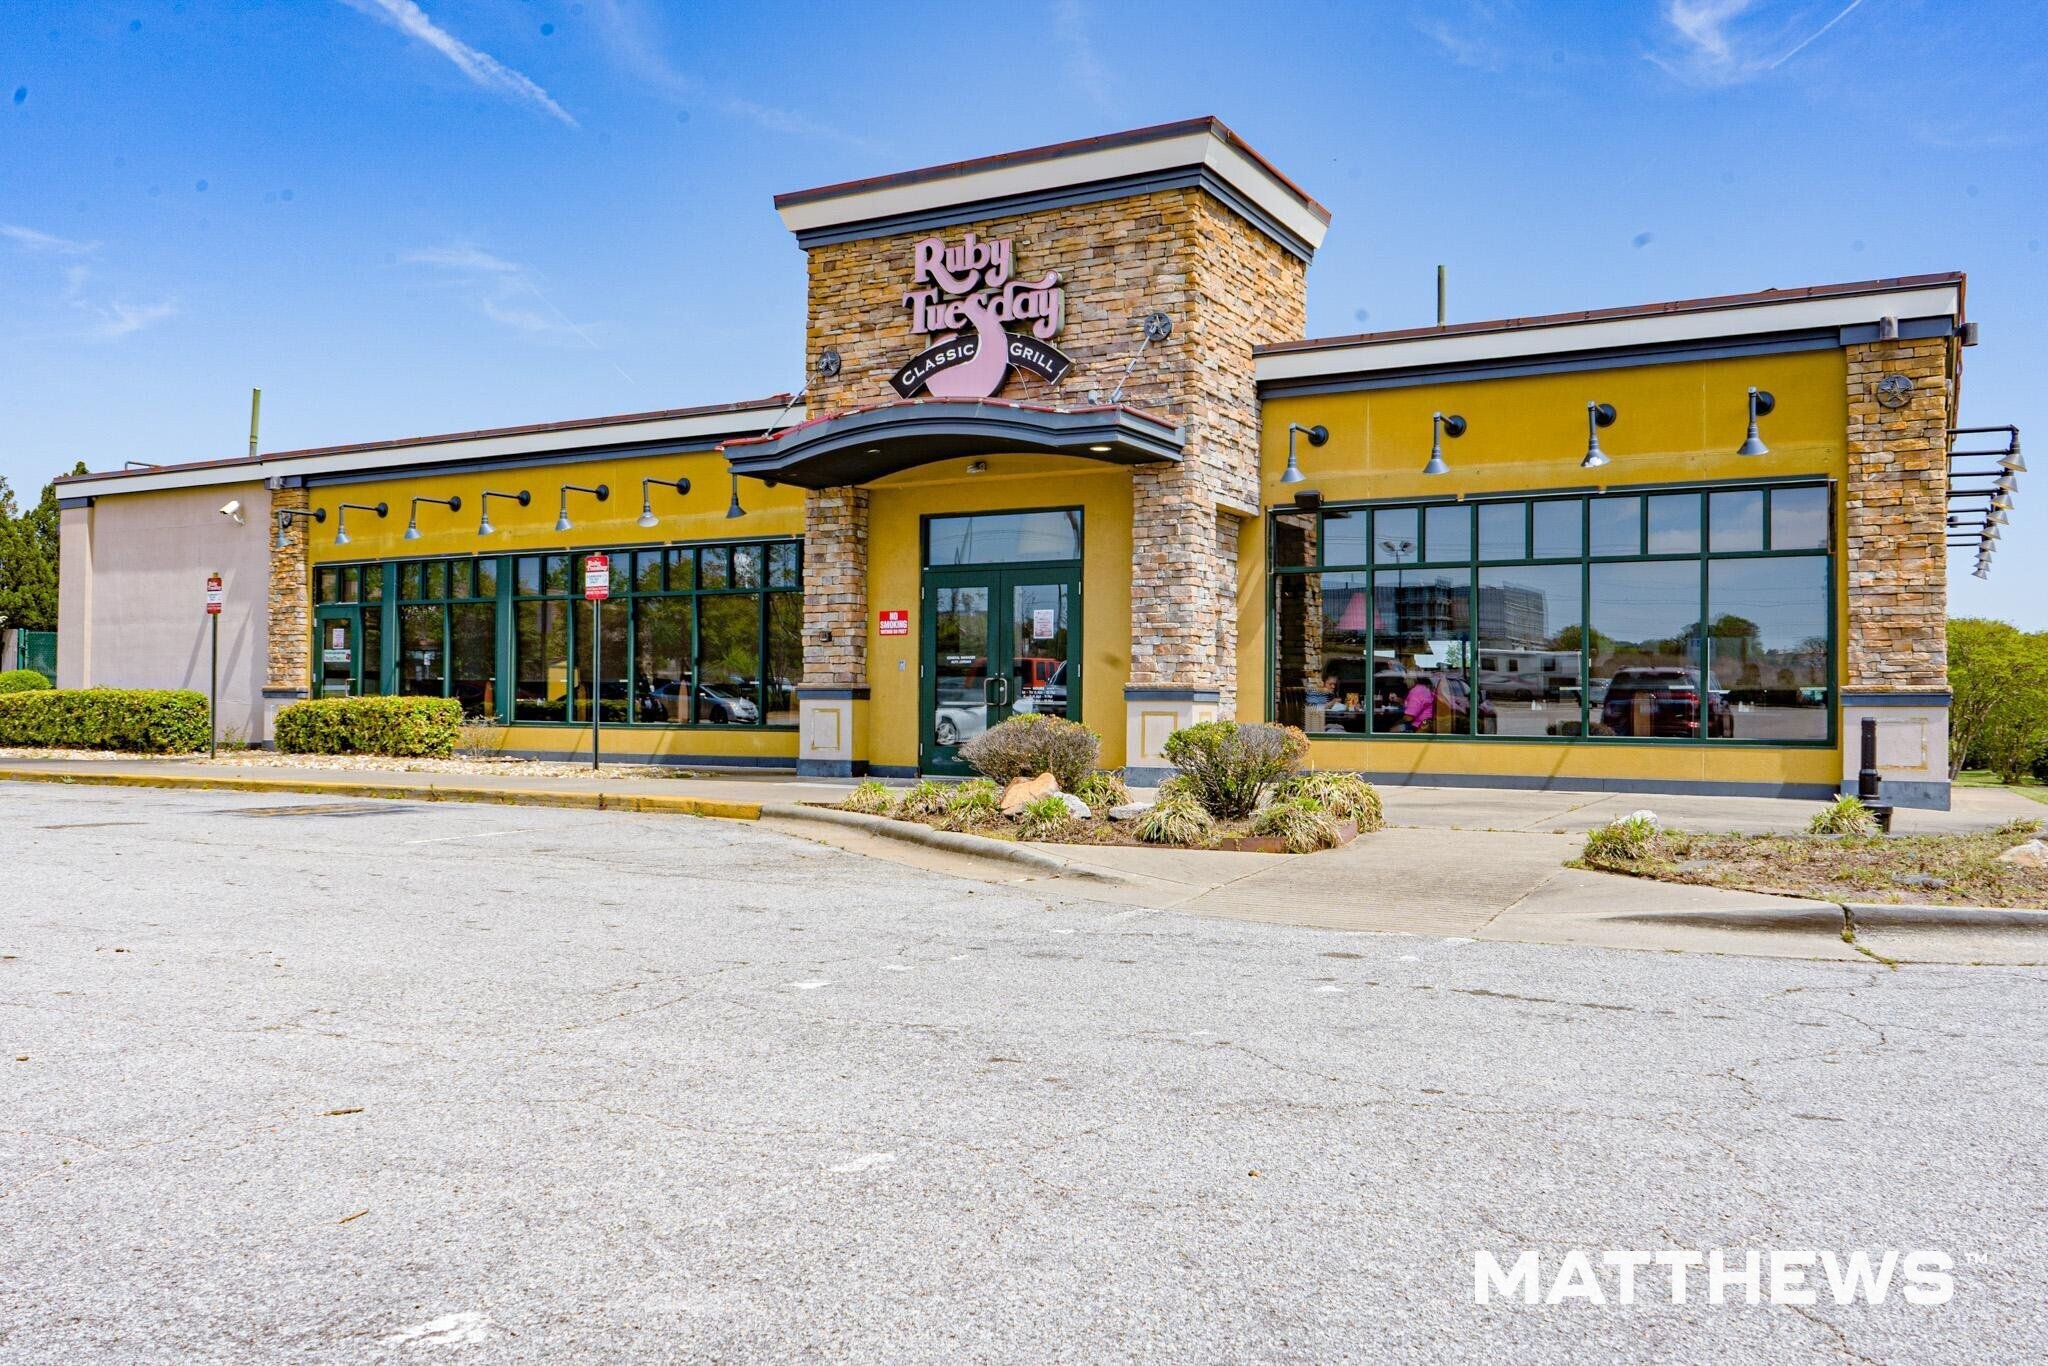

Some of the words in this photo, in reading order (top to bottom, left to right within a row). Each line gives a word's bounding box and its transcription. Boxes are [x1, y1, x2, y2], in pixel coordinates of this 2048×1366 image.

[912, 232, 1015, 295] Ruby
[902, 344, 975, 386] CLASSIC
[1009, 342, 1053, 373] GRILL
[880, 620, 907, 629] SMOKING
[889, 611, 899, 620] NO
